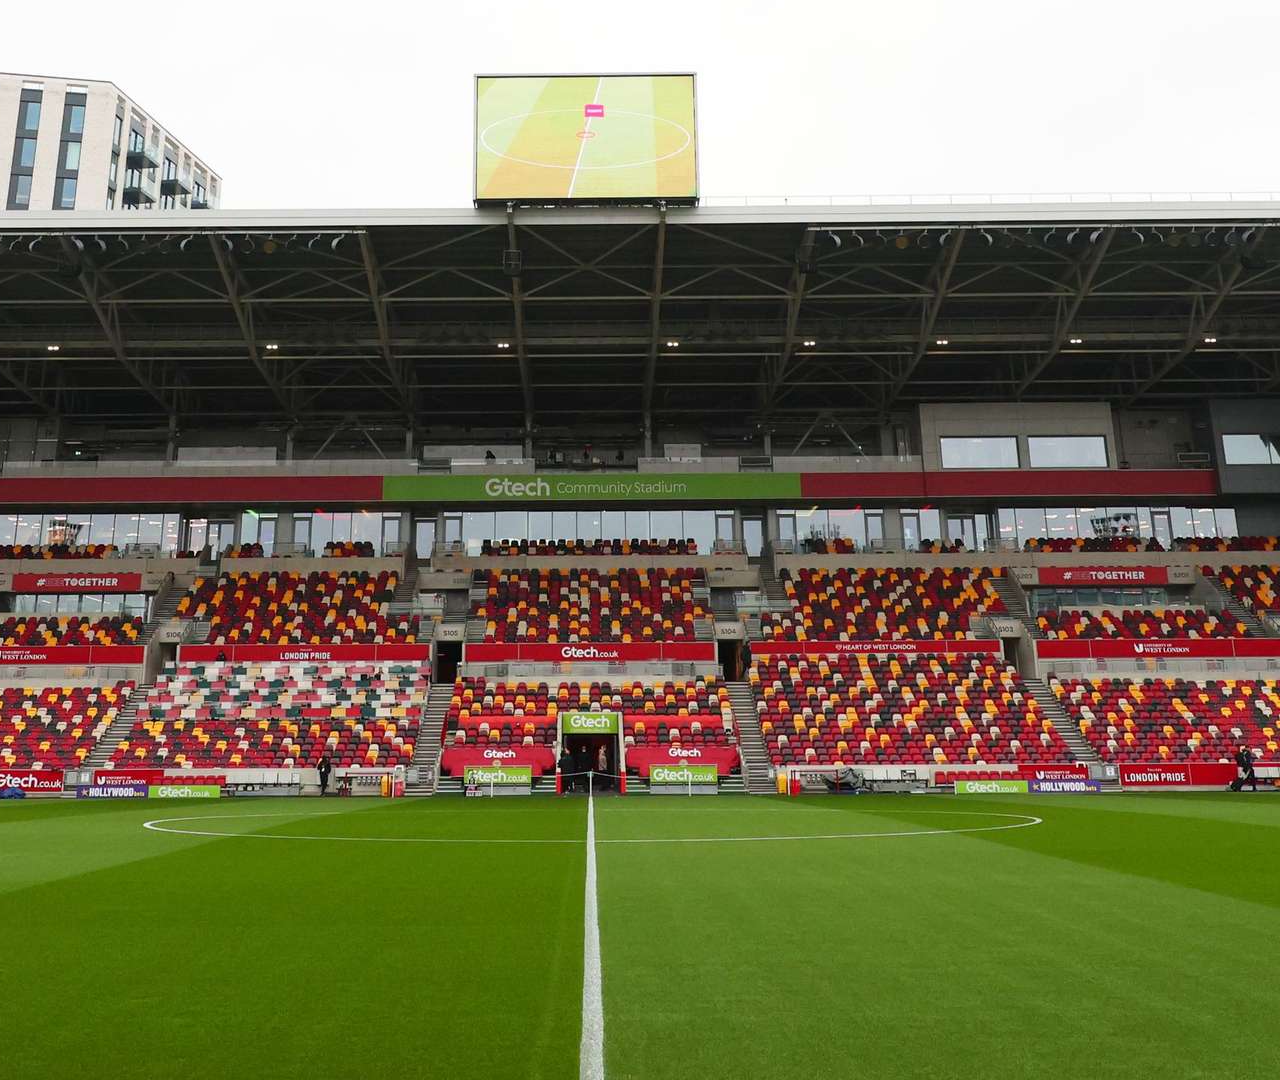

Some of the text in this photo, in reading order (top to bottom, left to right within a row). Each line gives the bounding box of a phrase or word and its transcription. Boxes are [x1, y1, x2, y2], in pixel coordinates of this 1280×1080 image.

[485, 478, 686, 496] Gtech Community Stadium
[280, 652, 308, 660] LONDON
[562, 646, 619, 658] Gtech.co.uk
[571, 715, 610, 728] Gtech
[483, 749, 516, 759] Gtech
[668, 748, 701, 757] Gtech
[468, 770, 528, 783] Gtech.co.uk
[653, 769, 713, 782] Gtech.co.uk
[1124, 773, 1186, 782] LONDON PRIDE
[158, 786, 210, 798] Gtech.co.uk
